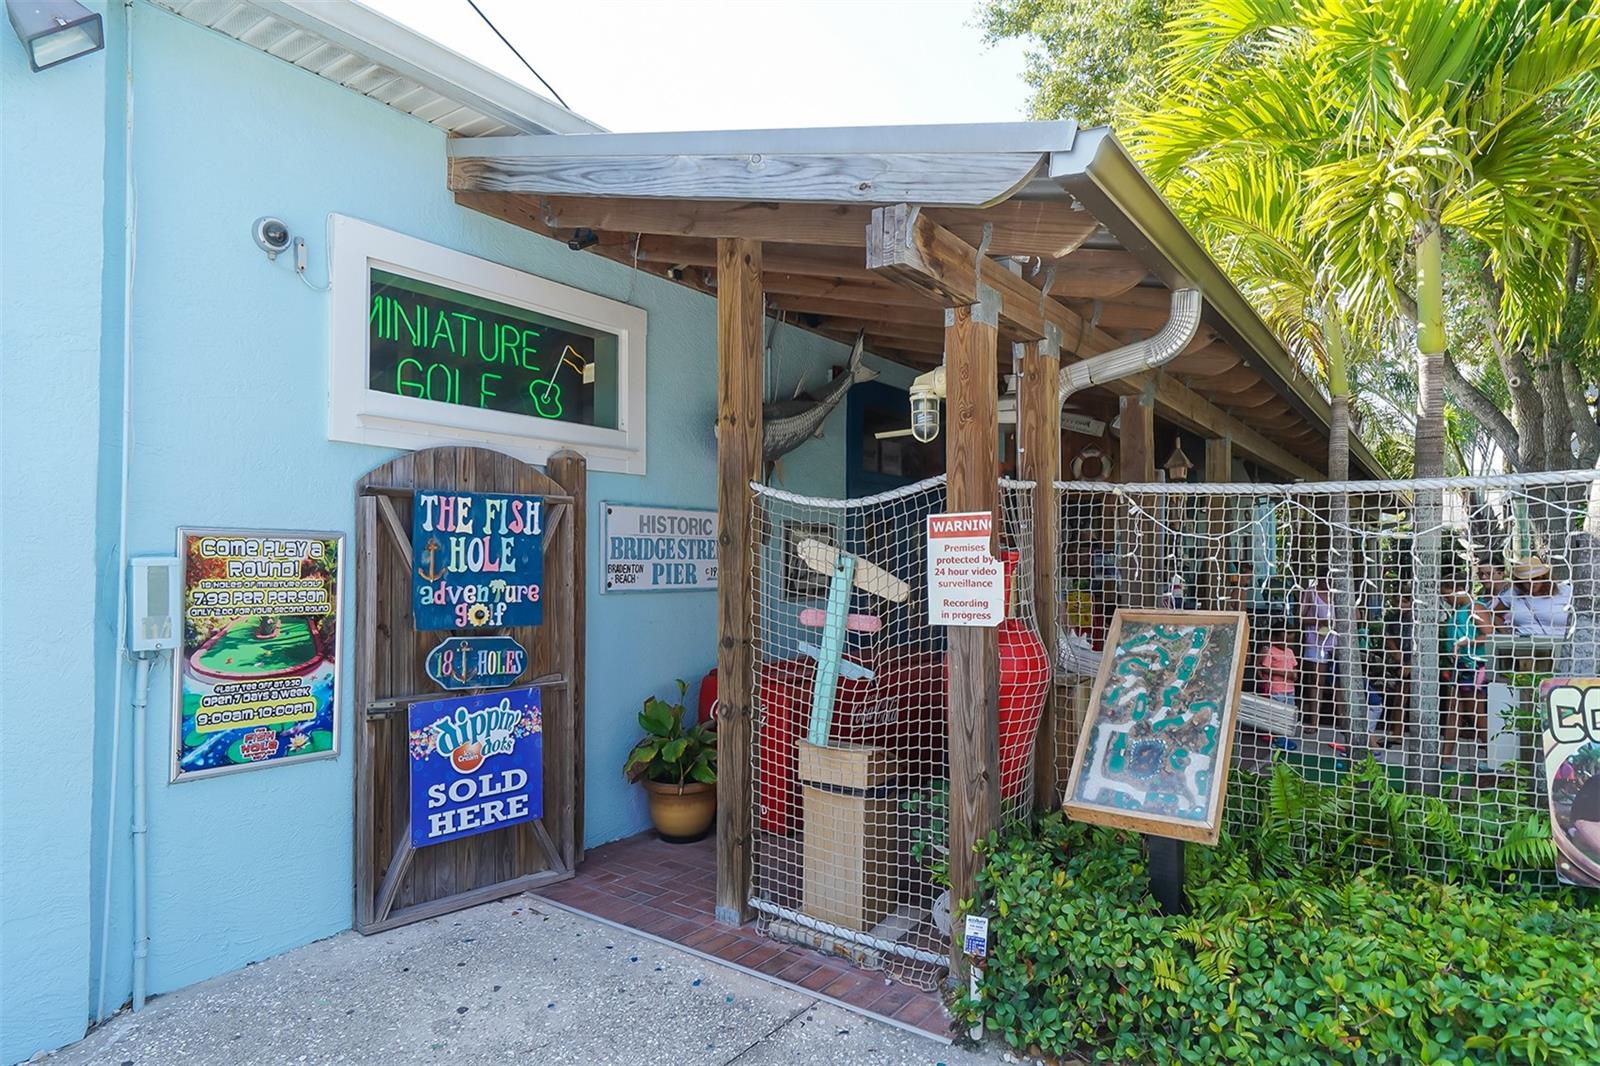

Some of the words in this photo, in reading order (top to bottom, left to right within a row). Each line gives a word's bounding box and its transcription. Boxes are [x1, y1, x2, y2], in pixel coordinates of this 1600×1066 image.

[420, 495, 473, 534] THE
[483, 498, 542, 535] FISH
[639, 514, 713, 535] HISTORIC
[448, 536, 517, 573] HOLE
[610, 536, 676, 560] BRIDGE
[677, 538, 719, 560] STRE
[944, 544, 985, 552] Premises
[607, 563, 644, 574] BRADENTON
[936, 556, 980, 565] protected
[982, 555, 994, 565] by
[614, 574, 637, 584] BEACH
[652, 563, 697, 586] PIER
[934, 568, 945, 576] 24
[947, 567, 968, 576] hour
[971, 567, 997, 576] video
[419, 579, 540, 605] adventure
[938, 579, 993, 588] surveillance
[193, 591, 230, 606] 7.98
[943, 599, 989, 609] Recording
[952, 611, 992, 620] progress
[435, 650, 454, 678] 18
[477, 650, 524, 676] HOLES
[438, 699, 521, 755] dippin'
[481, 738, 514, 756] dots
[427, 768, 529, 809] SOLD
[427, 794, 530, 839] HERE
